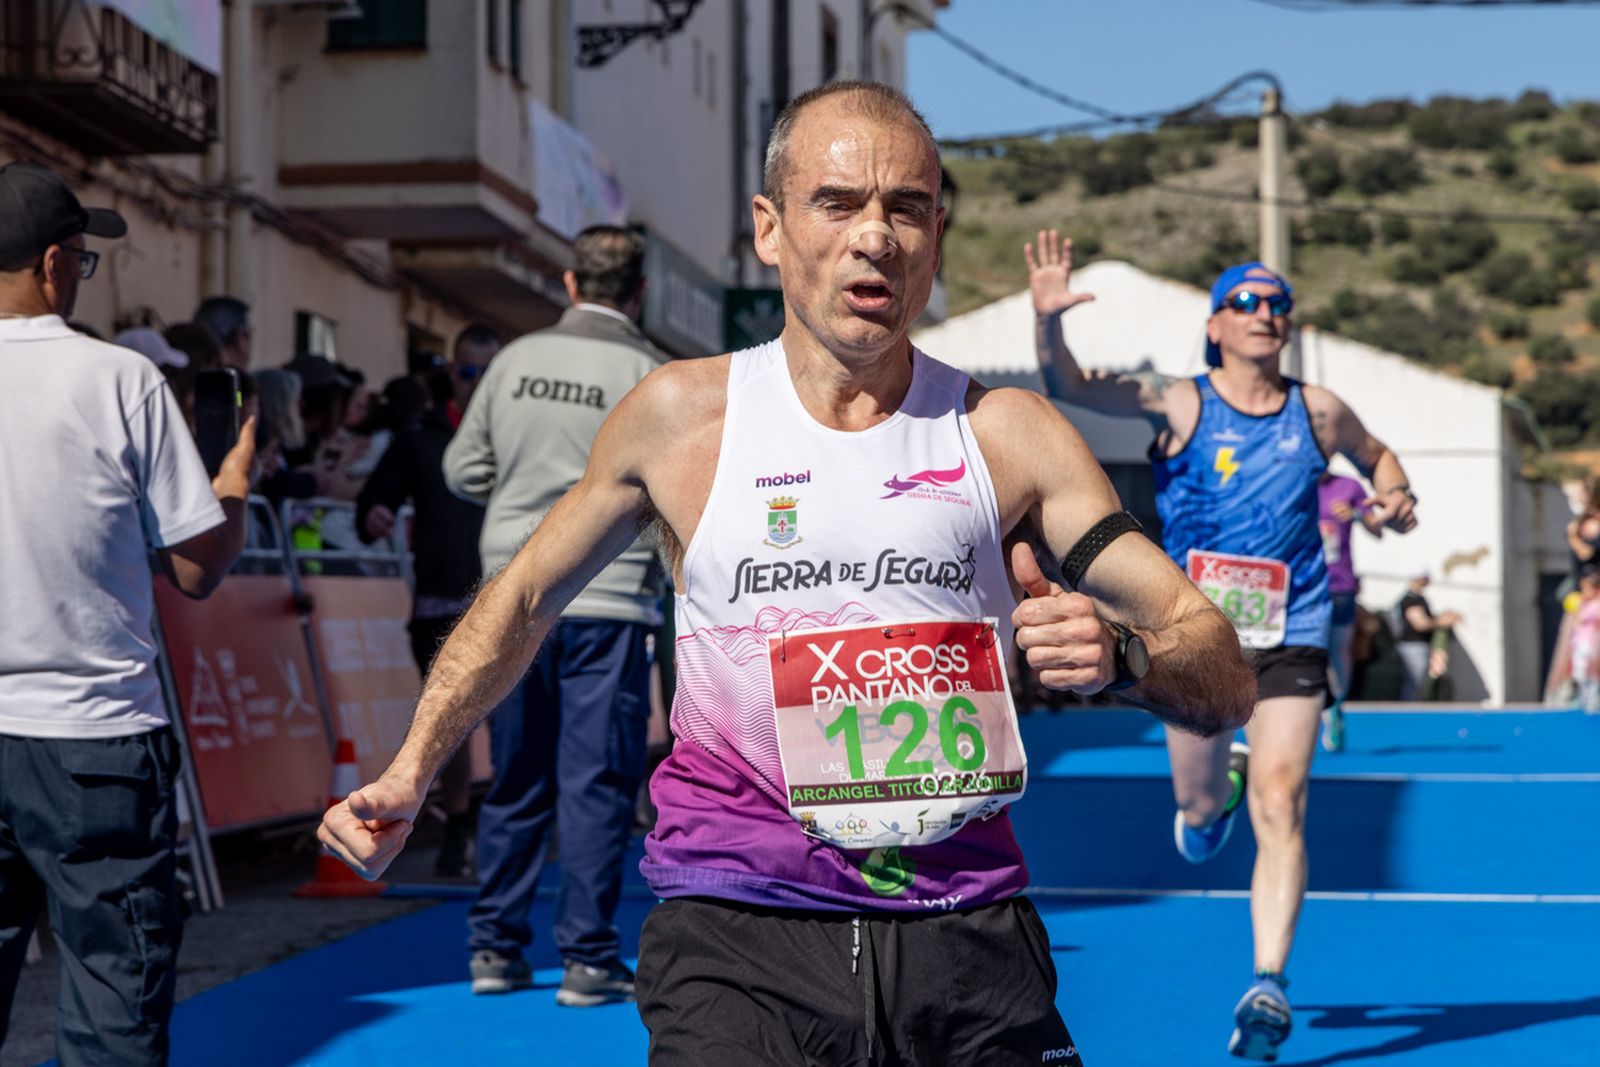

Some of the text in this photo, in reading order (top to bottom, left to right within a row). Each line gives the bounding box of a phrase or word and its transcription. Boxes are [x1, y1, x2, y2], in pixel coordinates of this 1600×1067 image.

[755, 469, 812, 489] mobel
[728, 548, 972, 604] SIERRA DE SEGURA
[1200, 557, 1218, 581] X
[806, 640, 850, 684] X
[855, 643, 970, 680] CROSS
[811, 674, 954, 713] PANTANO
[955, 680, 976, 693] DEL
[825, 695, 987, 780] 126
[820, 761, 845, 774] LAS
[791, 783, 885, 803] ARCANGEL
[888, 780, 937, 797] TITOS
